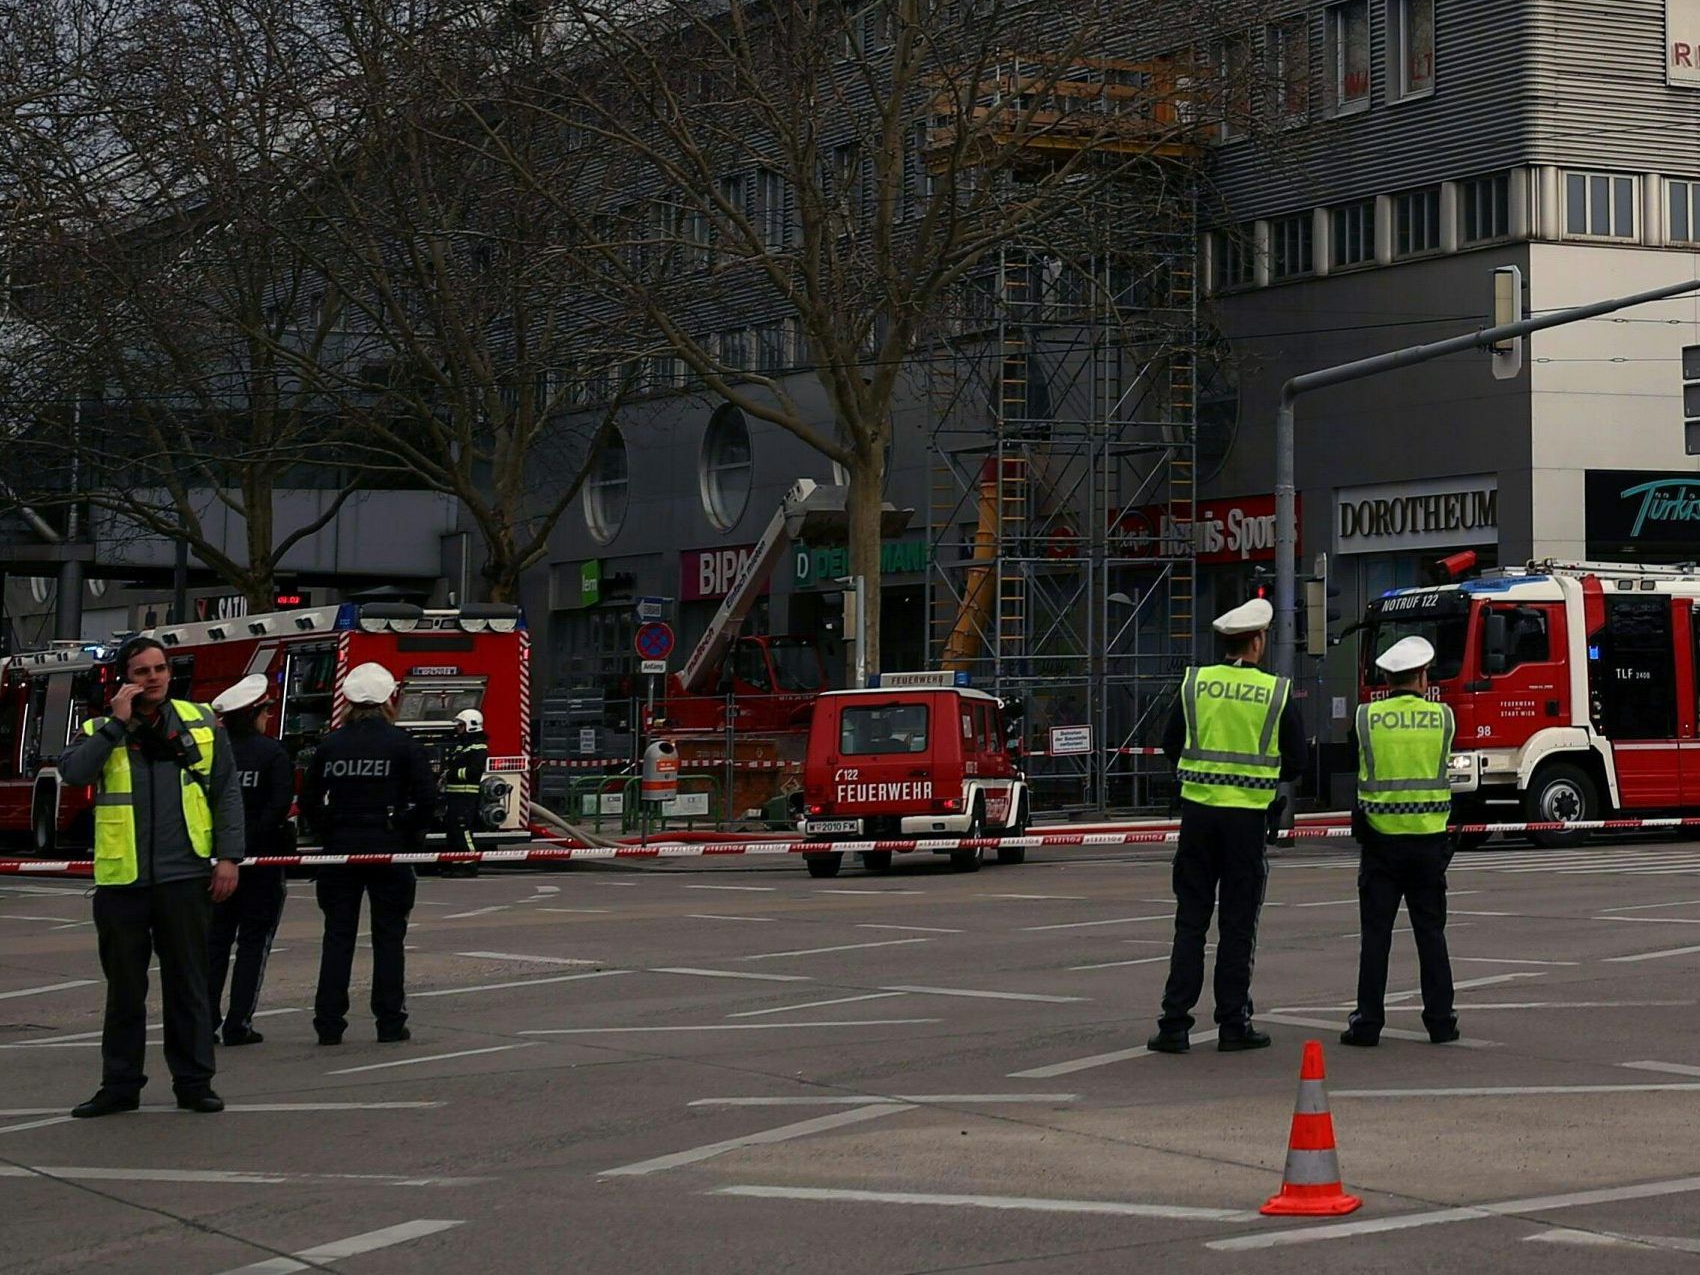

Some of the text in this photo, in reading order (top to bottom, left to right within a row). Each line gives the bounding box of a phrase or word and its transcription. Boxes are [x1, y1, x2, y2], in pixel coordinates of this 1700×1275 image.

[1340, 489, 1498, 538] DOROTHEUM
[1381, 594, 1439, 612] NOTRUF 122
[891, 675, 944, 685] FEUERWEHR
[1616, 668, 1634, 680] TLF
[1196, 680, 1271, 705] POLIZEI
[1477, 725, 1492, 737] 98
[323, 759, 391, 778] POLIZEI
[844, 769, 859, 780] 122
[837, 781, 933, 803] FEUERWEHR
